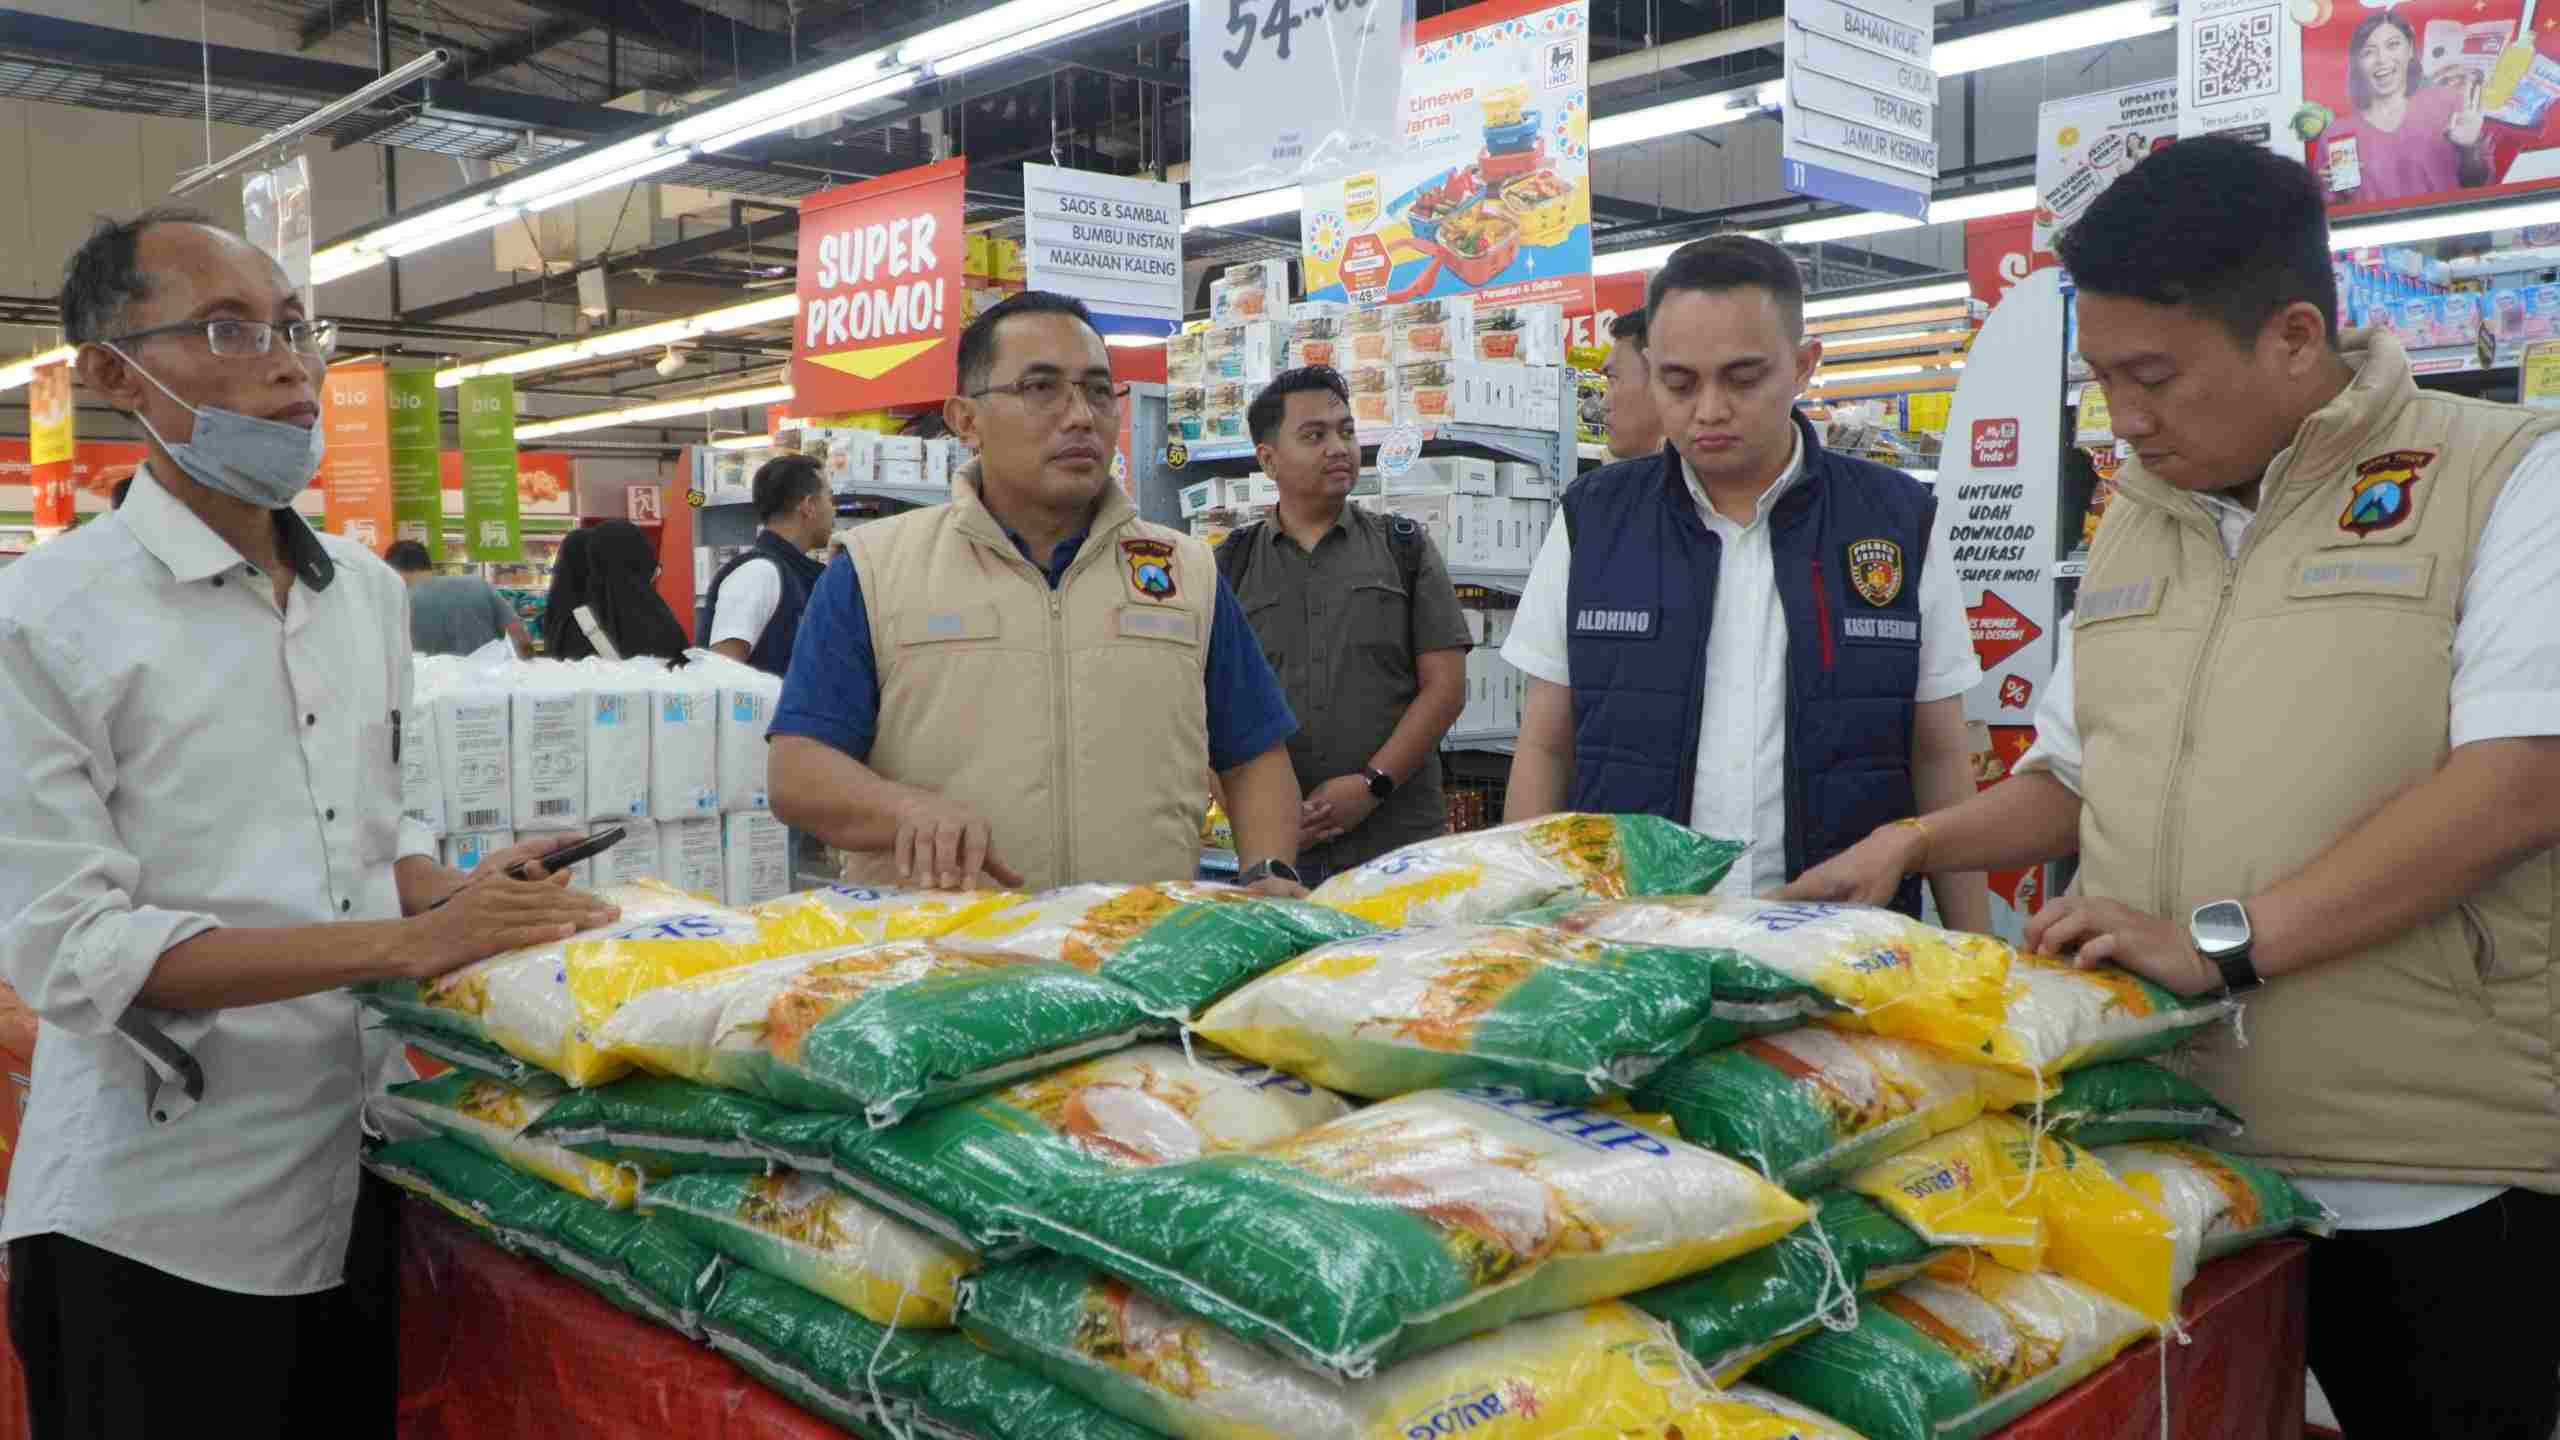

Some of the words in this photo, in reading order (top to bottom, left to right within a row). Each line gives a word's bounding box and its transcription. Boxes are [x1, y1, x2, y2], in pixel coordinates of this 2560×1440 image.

[1844, 12, 1889, 45] BAHAN
[1893, 32, 1920, 55] KUE
[1897, 67, 1933, 91] GULA
[1873, 96, 1923, 128] TEPUNG
[1842, 126, 1888, 157] JAMUR
[1890, 141, 1936, 168] KERING
[1059, 198, 1097, 217] SAOS
[1101, 204, 1112, 217] &
[1115, 205, 1170, 225] SAMBAL
[1072, 225, 1123, 246] BUMBU
[1127, 232, 1175, 251] INSTAN
[817, 213, 938, 289] SUPER
[1050, 250, 1122, 271] MAKANAN
[1125, 256, 1176, 277] KALENG
[806, 277, 944, 348] PROMO!
[333, 386, 368, 407] bio
[389, 390, 421, 409] bio
[1958, 484, 2023, 500] UNTUNG
[1968, 504, 2012, 520] UDAH
[1949, 525, 2035, 541] DOWNLOAD
[1953, 545, 2025, 561] APLIKASI
[1961, 568, 2001, 581] SUPER
[1576, 610, 1649, 632] ALDHINO
[1844, 617, 1876, 637] KASAT
[1407, 1391, 1505, 1440] BULOG
